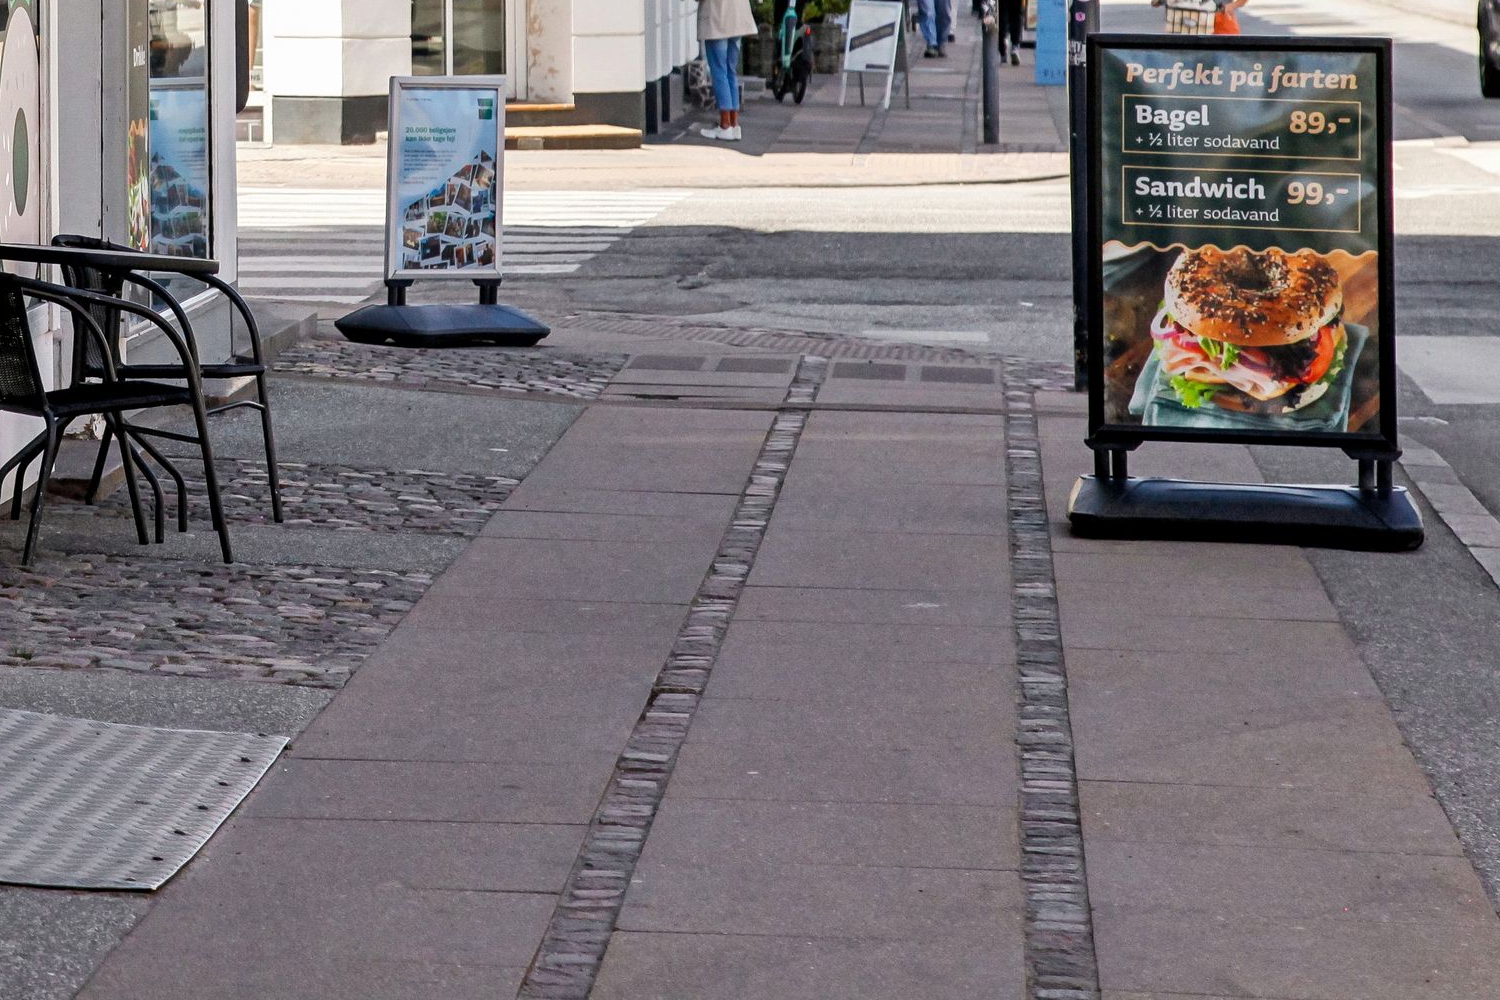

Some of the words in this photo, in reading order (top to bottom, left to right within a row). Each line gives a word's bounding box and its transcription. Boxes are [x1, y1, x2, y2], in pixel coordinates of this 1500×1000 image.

[1126, 62, 1222, 90] Perfekt
[1230, 63, 1264, 92] på
[1268, 65, 1358, 93] farten
[1135, 104, 1209, 132] Bagel
[1289, 110, 1351, 135] 89,-
[1167, 133, 1199, 148] liter
[1203, 135, 1280, 150] sodavand
[1135, 176, 1266, 200] Sandwich
[1286, 181, 1349, 206] 99,-
[1167, 205, 1199, 220] liter
[1203, 207, 1280, 222] sodavand
